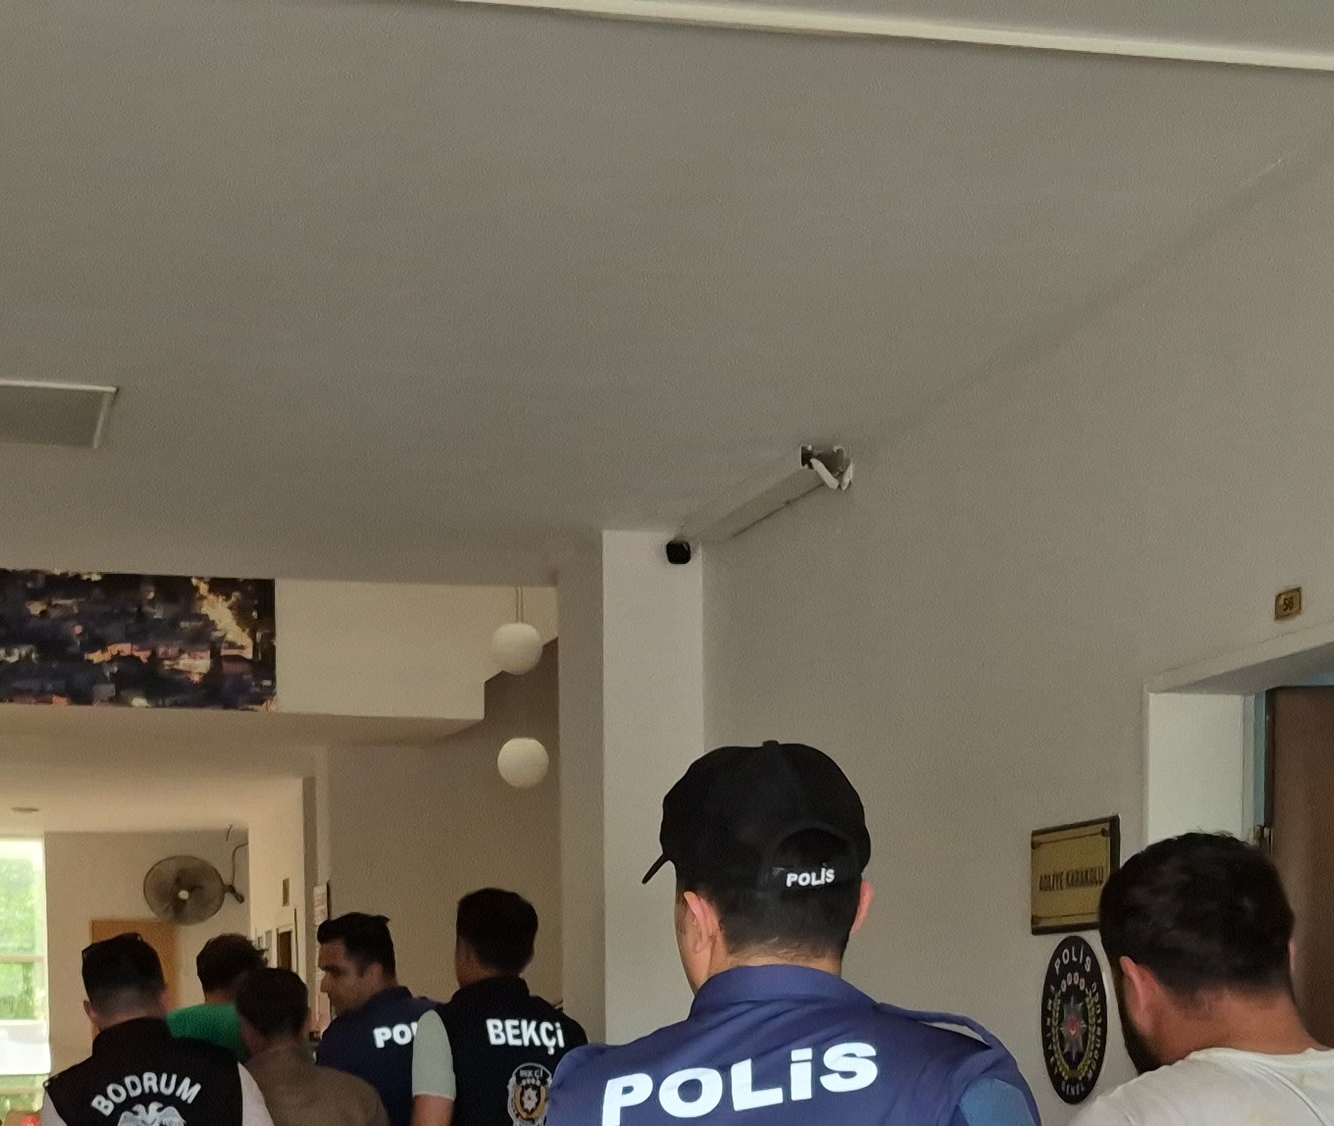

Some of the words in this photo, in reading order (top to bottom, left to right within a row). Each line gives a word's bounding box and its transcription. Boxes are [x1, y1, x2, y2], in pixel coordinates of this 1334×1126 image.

[786, 862, 835, 887] POLİS
[1054, 945, 1092, 975] POLİS
[91, 1071, 202, 1117] BODRUM
